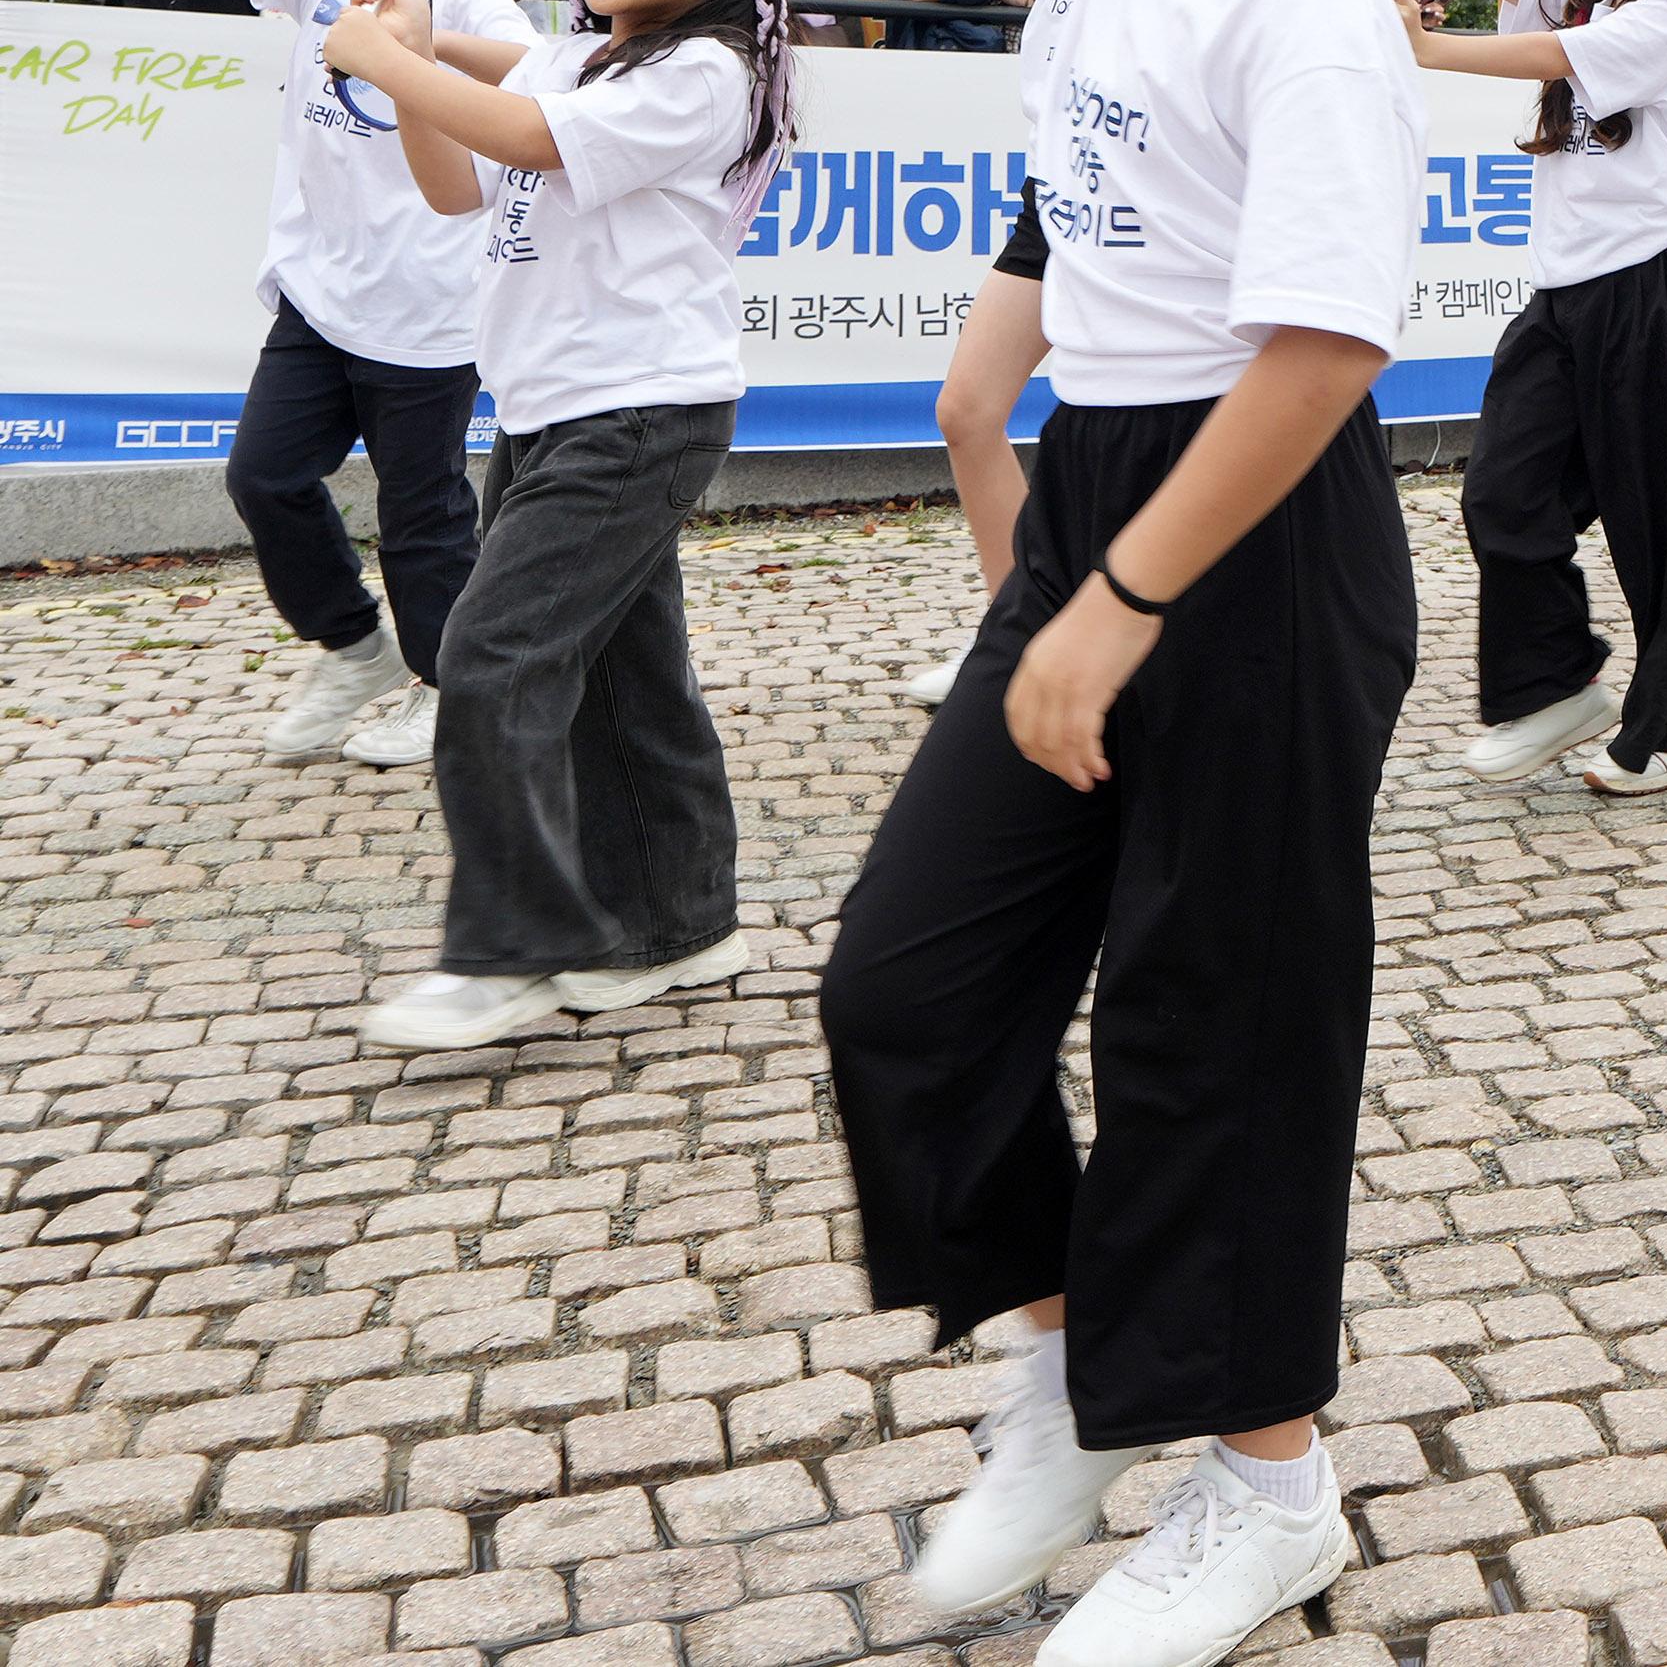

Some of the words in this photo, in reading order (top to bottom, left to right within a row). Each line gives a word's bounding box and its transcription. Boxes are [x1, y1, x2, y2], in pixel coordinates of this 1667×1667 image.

[0, 40, 91, 85] AR
[112, 47, 245, 91] FREE
[63, 93, 165, 141] DAY
[737, 150, 1027, 257] 께하
[788, 293, 904, 340] 광주시
[1435, 276, 1535, 319] 캠페인
